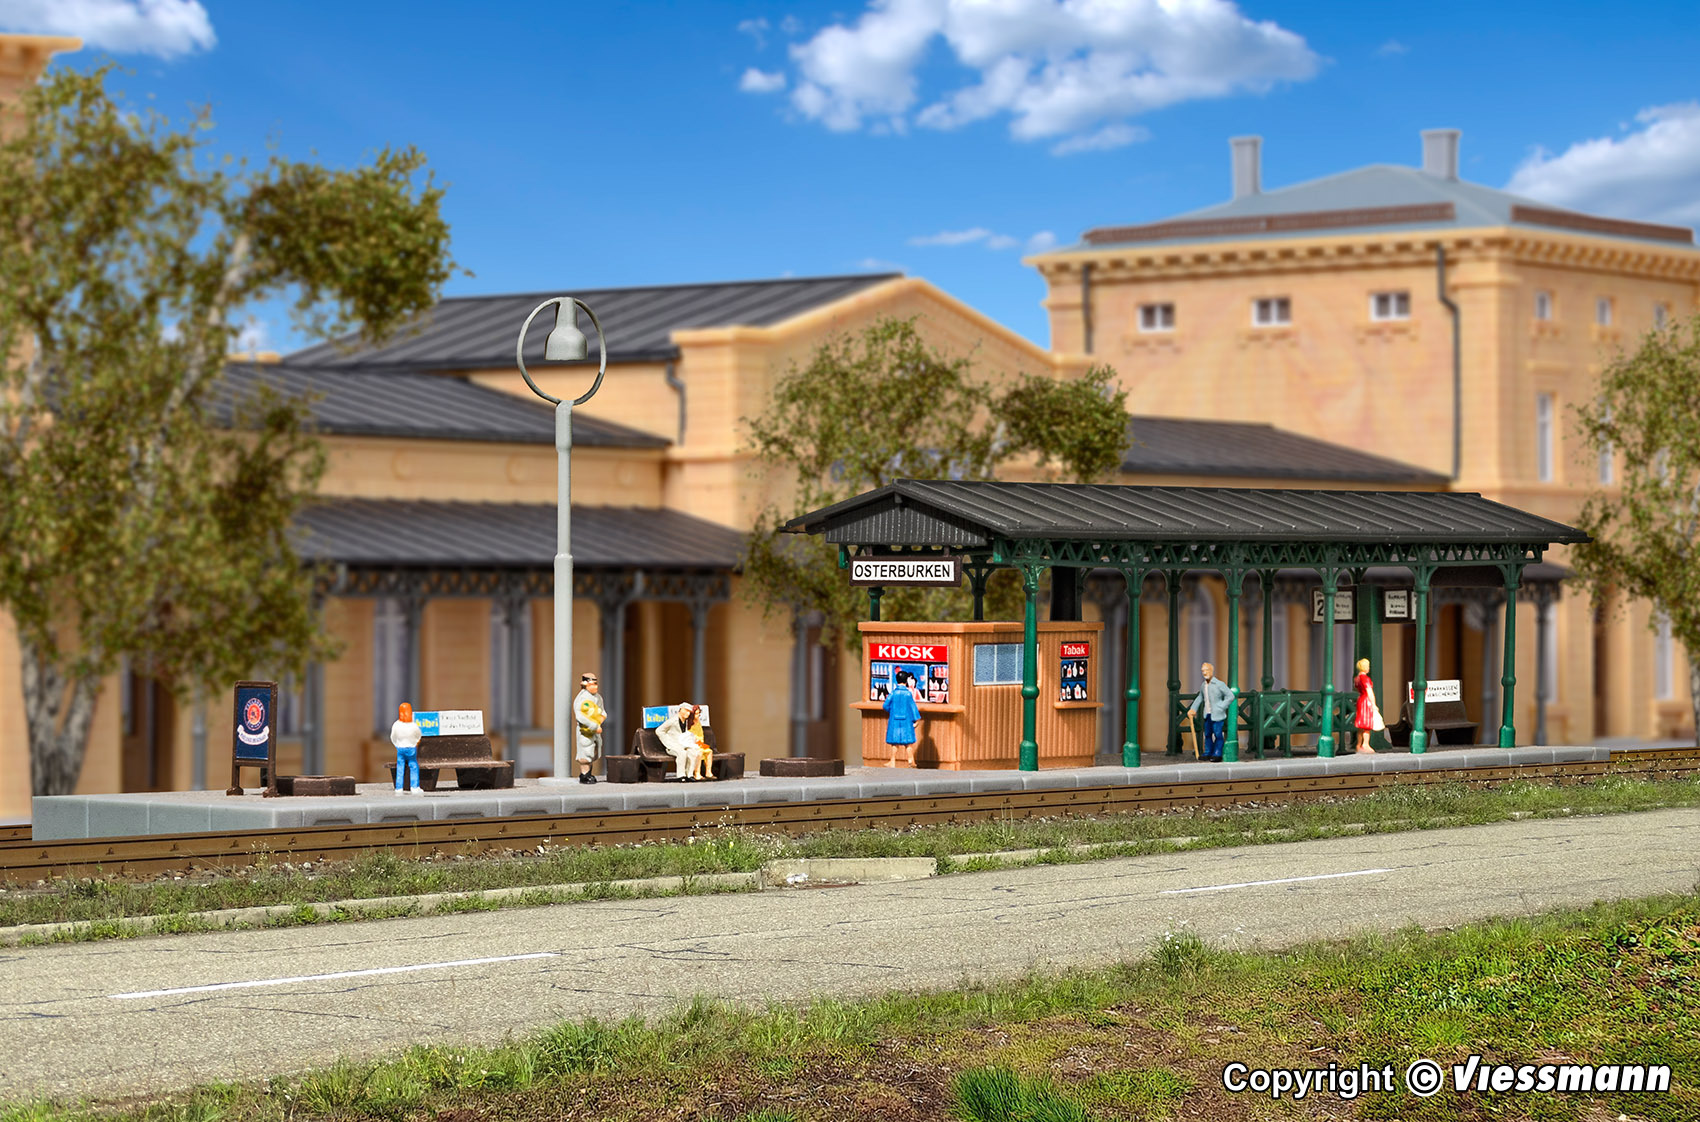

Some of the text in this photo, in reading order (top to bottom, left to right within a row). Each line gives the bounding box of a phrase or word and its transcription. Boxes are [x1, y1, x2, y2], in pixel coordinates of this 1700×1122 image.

[854, 564, 950, 578] OSTERBURKEN
[1317, 599, 1324, 617] 2
[878, 645, 935, 660] KIOSK
[1063, 645, 1086, 655] Tabak
[415, 718, 439, 728] kibri
